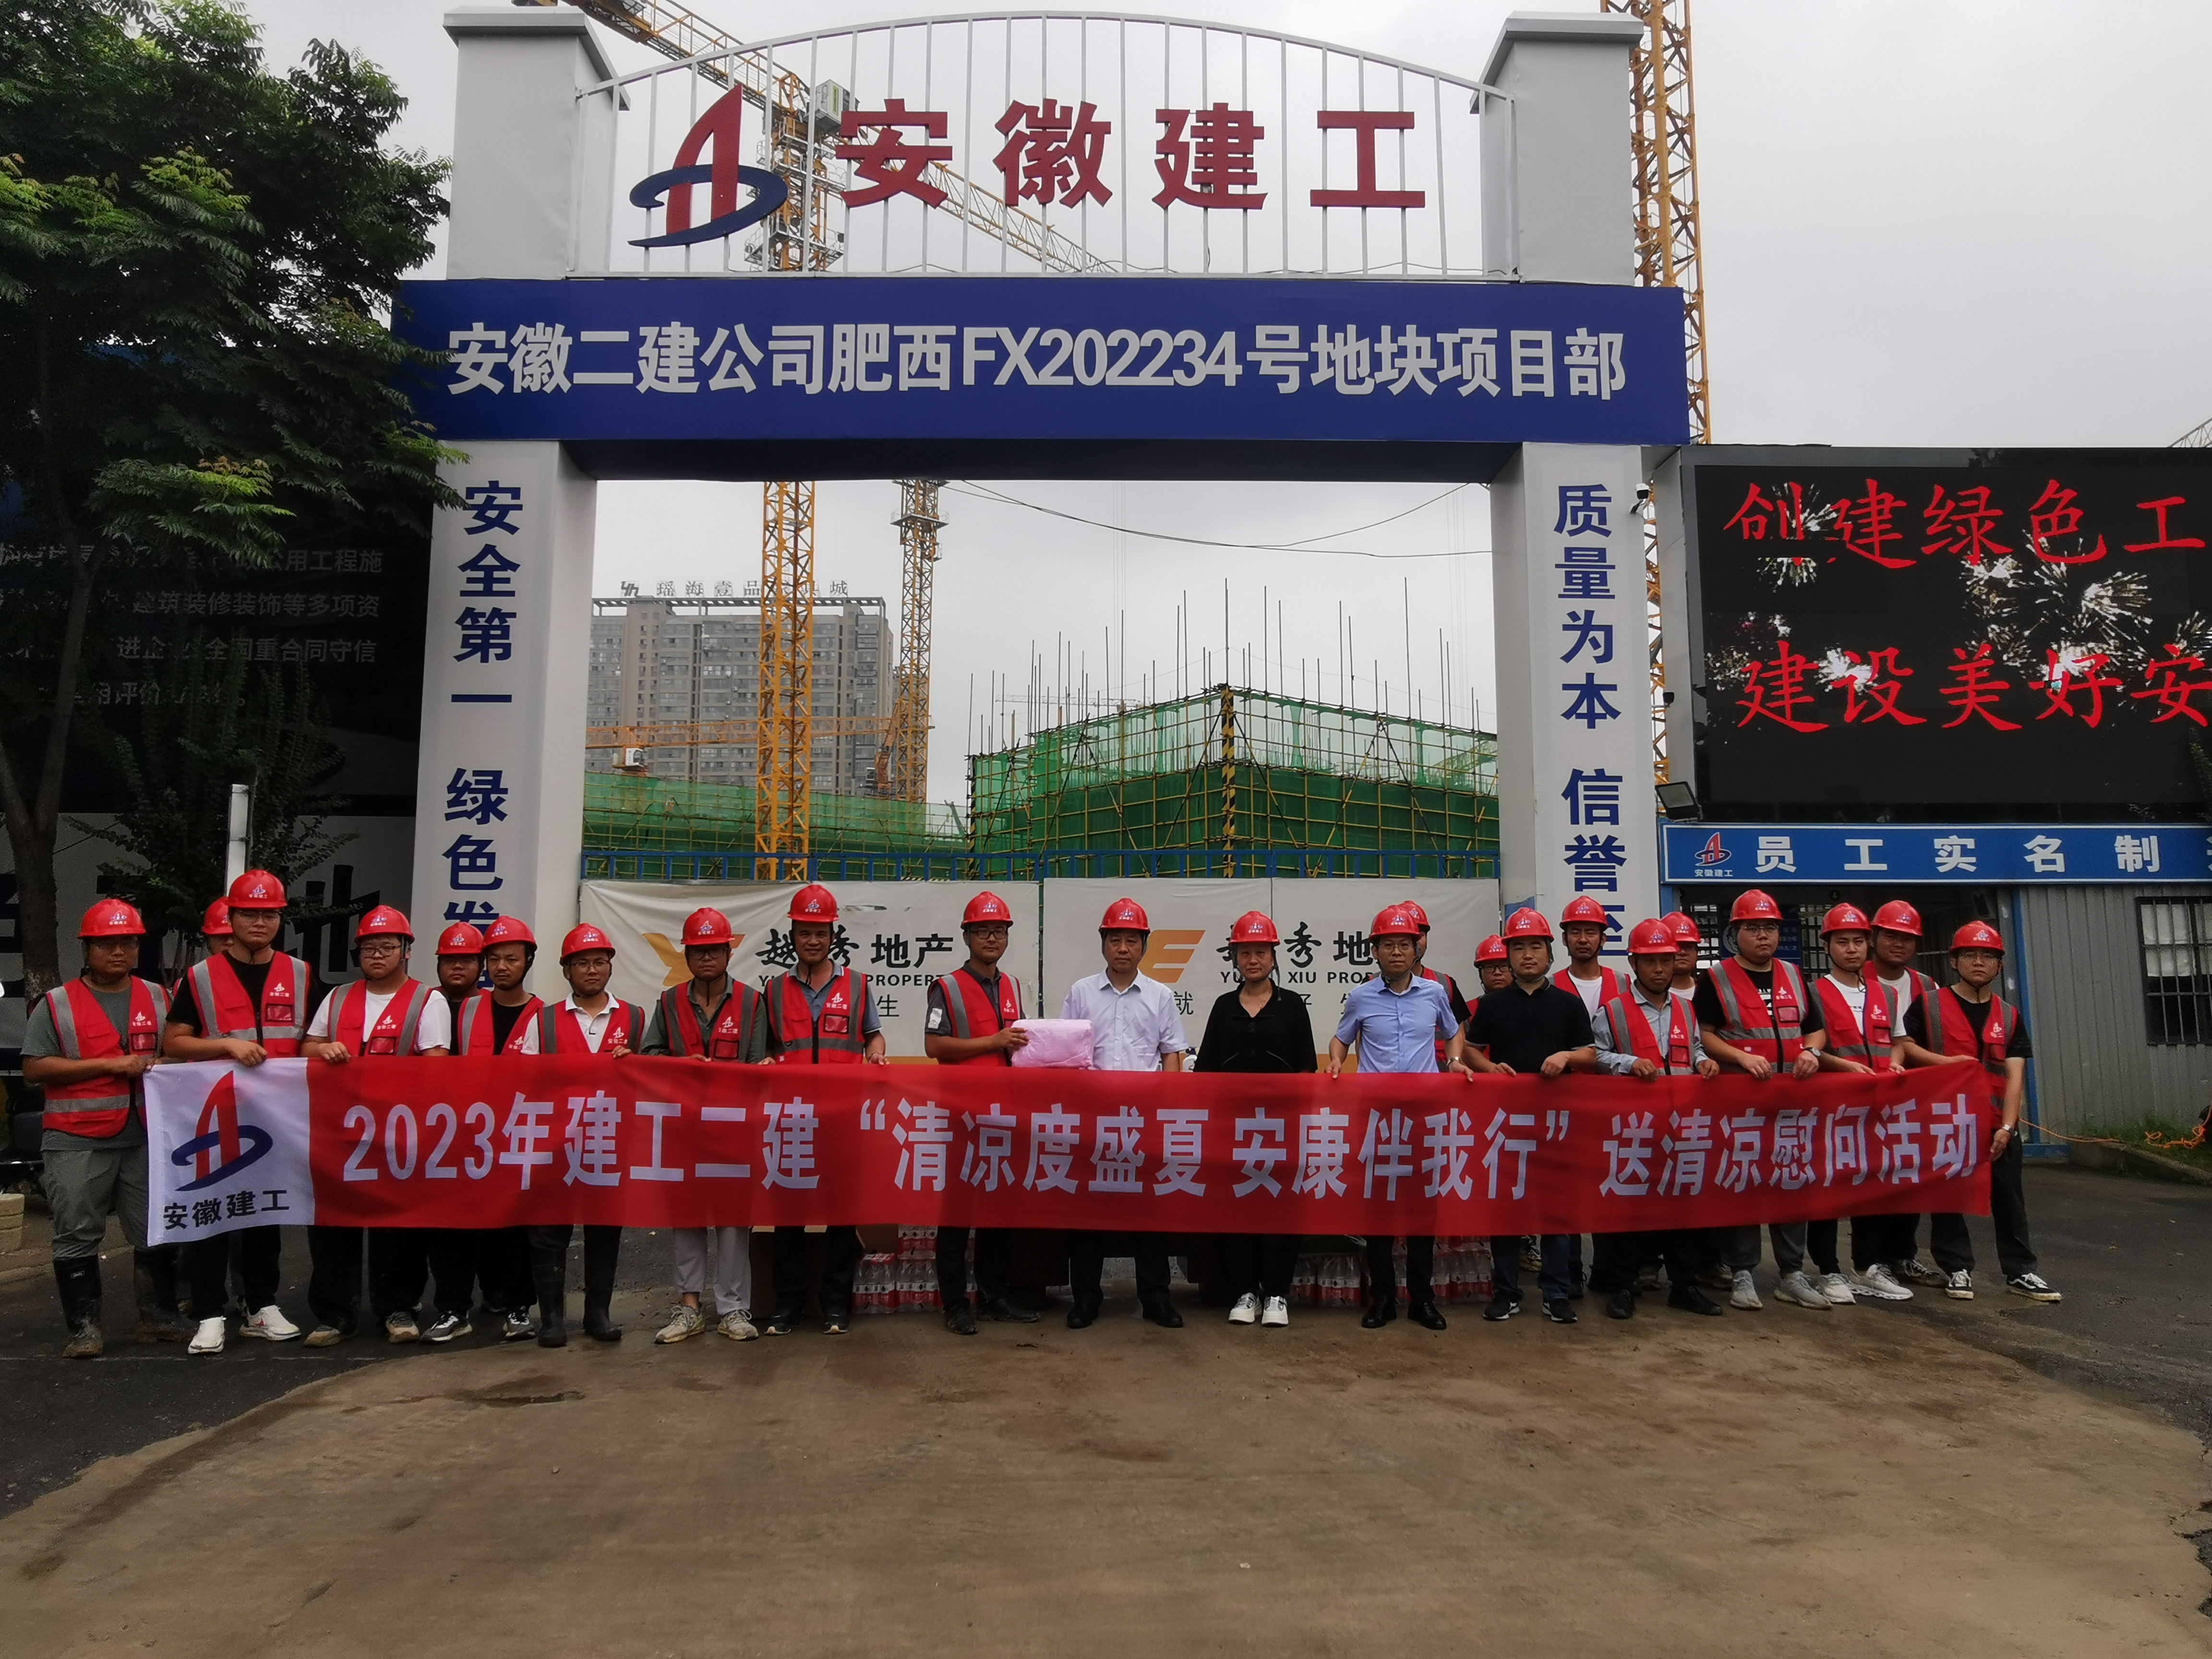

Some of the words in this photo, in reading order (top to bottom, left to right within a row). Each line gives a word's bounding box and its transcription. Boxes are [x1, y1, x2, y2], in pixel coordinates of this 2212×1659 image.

[834, 98, 1426, 210] 安徽建工
[446, 321, 1627, 401] 安徽二建公司肥西FX202234号地块项目部
[1723, 478, 2207, 569] 创建绿色工
[452, 480, 524, 703] 安全第一
[1553, 484, 1622, 729] 质量为本
[1736, 639, 2212, 734] 建设美好安
[442, 768, 509, 988] 绿色
[1755, 834, 2212, 874] 员工实名制
[877, 994, 900, 1017] 生
[1287, 972, 1317, 984] XIU
[343, 1090, 819, 1191] 2023年建工二建
[859, 1096, 1210, 1197] “清凉度盛夏
[1231, 1106, 1569, 1202] 安康伴我行”
[1599, 1093, 1978, 1197] 送清凉慰问活动
[162, 1189, 290, 1231] 安徽建工
